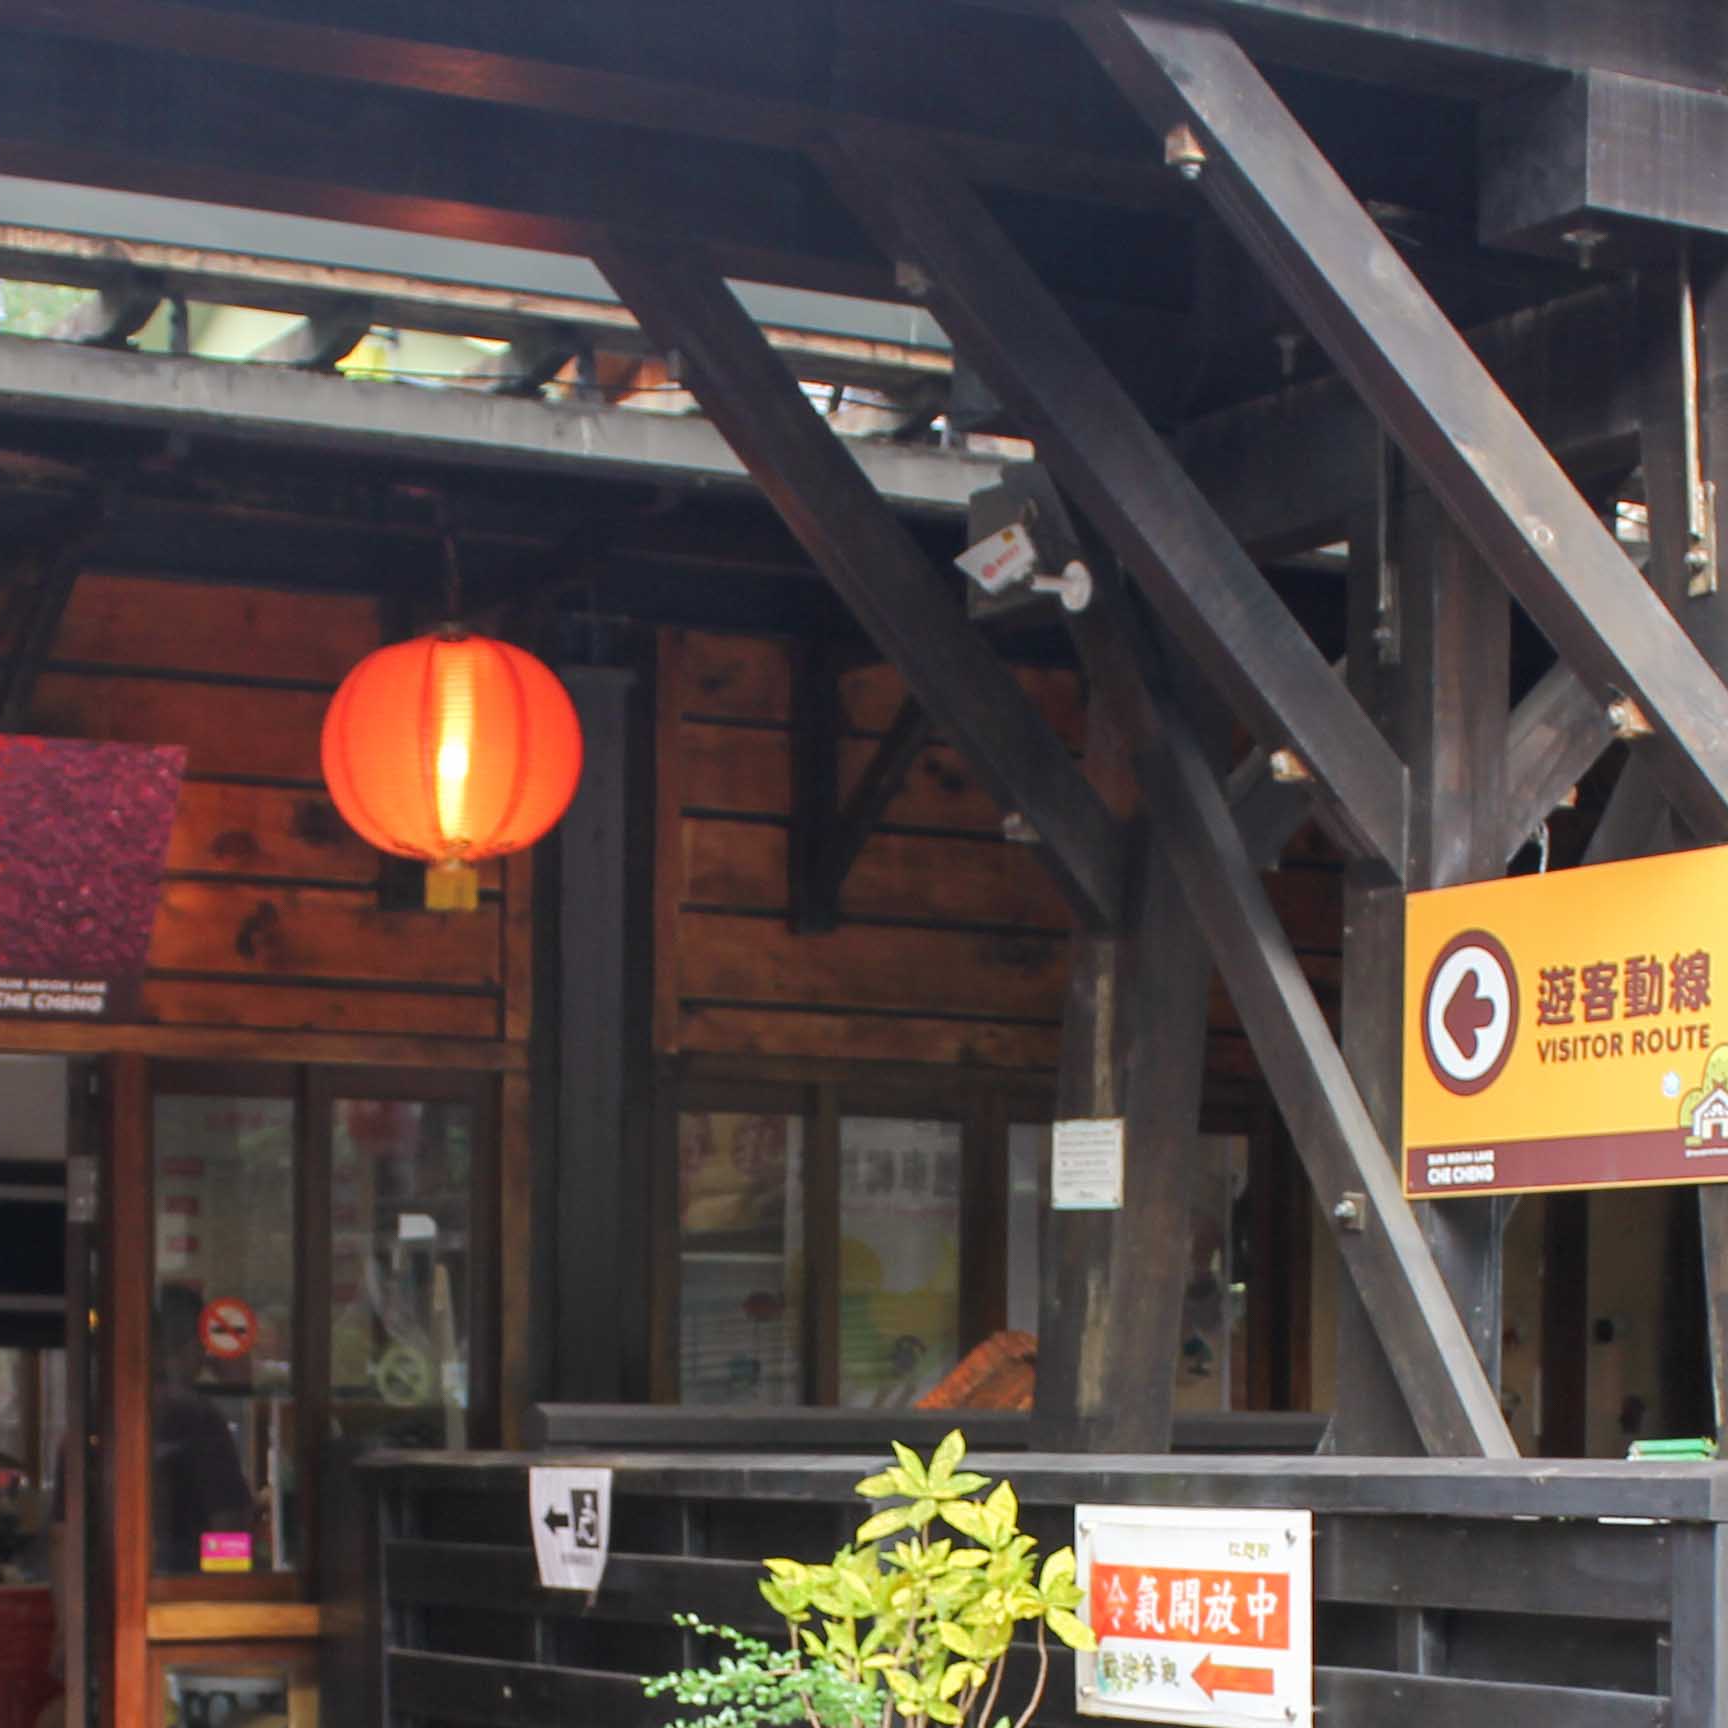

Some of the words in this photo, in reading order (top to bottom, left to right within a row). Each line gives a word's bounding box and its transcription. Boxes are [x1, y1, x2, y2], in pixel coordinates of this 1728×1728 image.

[34, 993, 103, 1012] CHENG
[1537, 949, 1711, 1027] 遊客動線
[1536, 1032, 1623, 1063] VISITOR
[1632, 1024, 1710, 1055] ROUTE
[1428, 1167, 1451, 1185] CHE
[1103, 1574, 1278, 1640] 冷氣開放中
